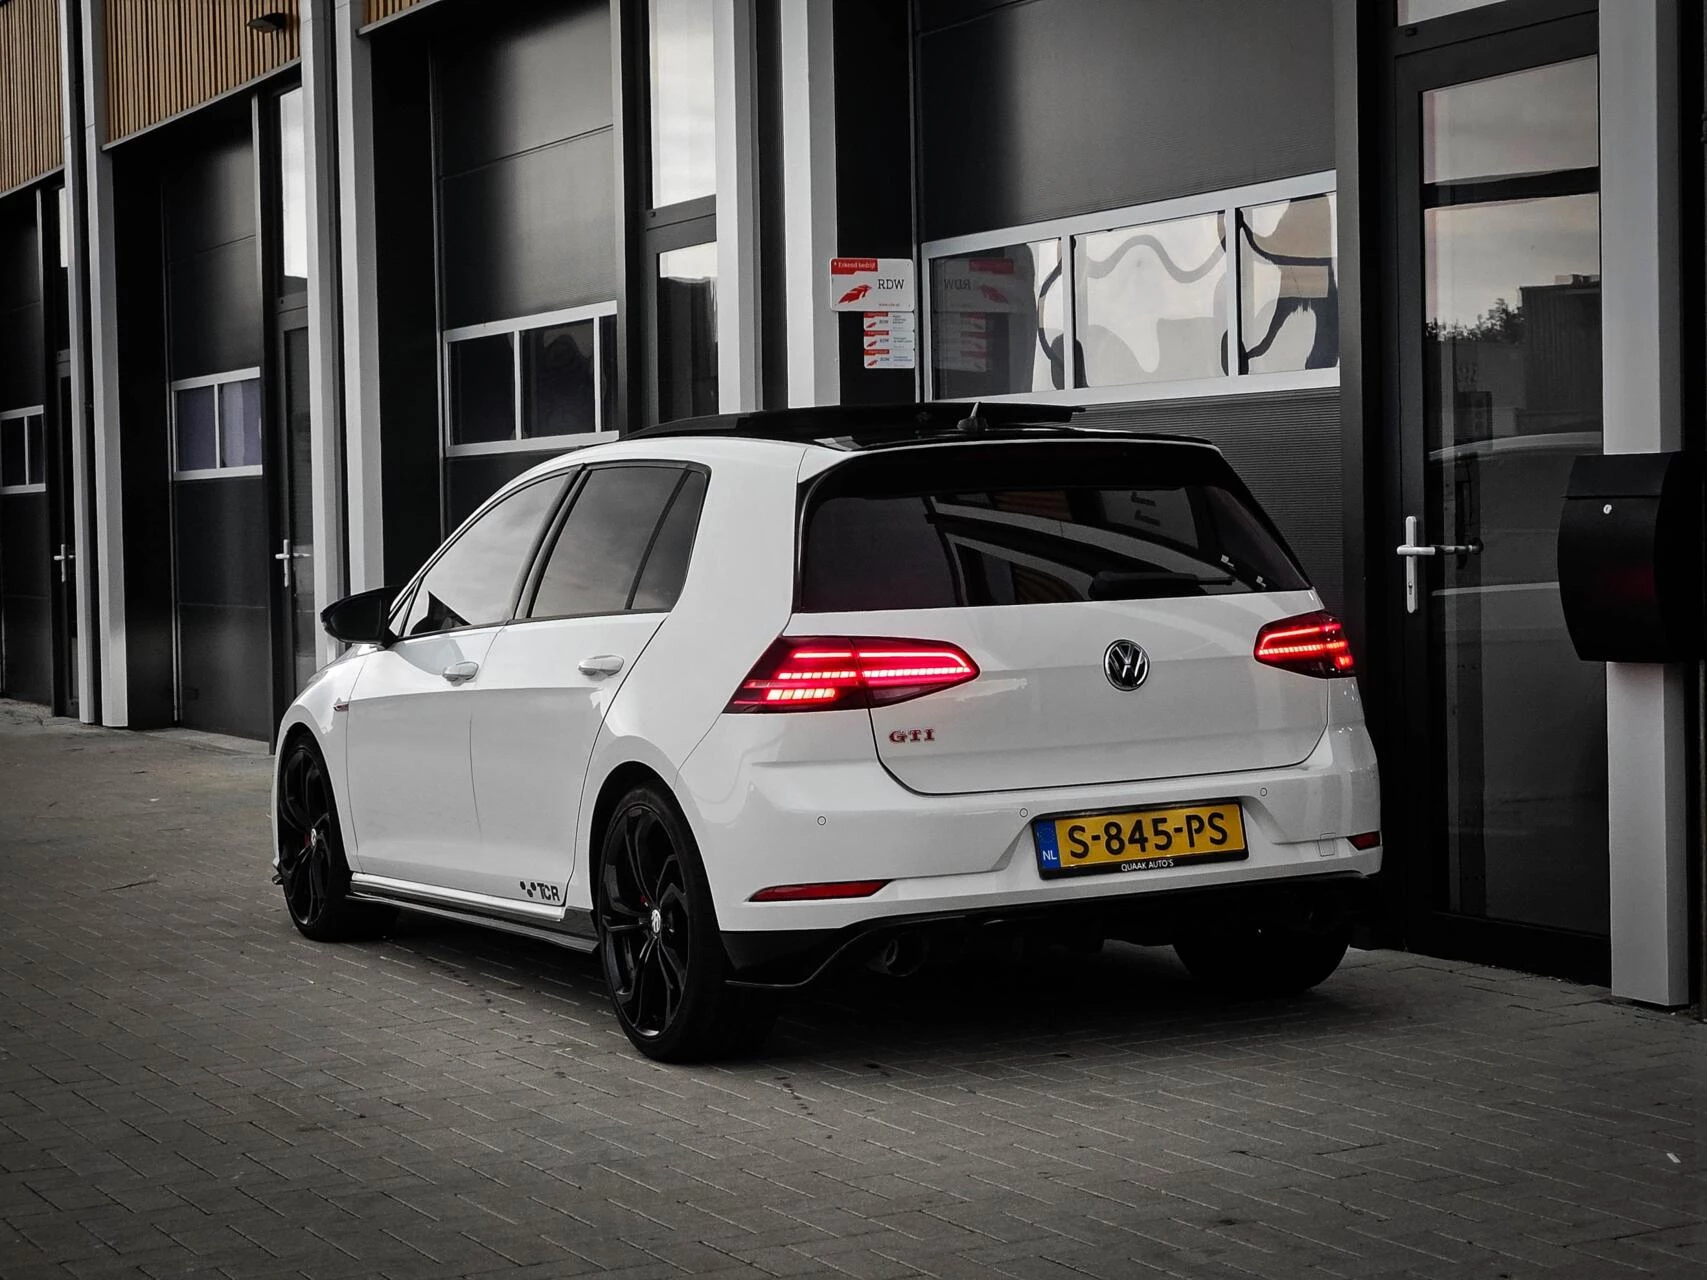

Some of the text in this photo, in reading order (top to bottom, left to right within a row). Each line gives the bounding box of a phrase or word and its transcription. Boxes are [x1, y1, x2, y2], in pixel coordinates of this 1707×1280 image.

[878, 278, 905, 290] RDW
[889, 728, 935, 743] GTI
[1067, 812, 1228, 859] S-845-PS
[1042, 850, 1058, 861] NL
[1121, 859, 1174, 872] QUAAK AUTO'S
[536, 882, 561, 902] TCR
